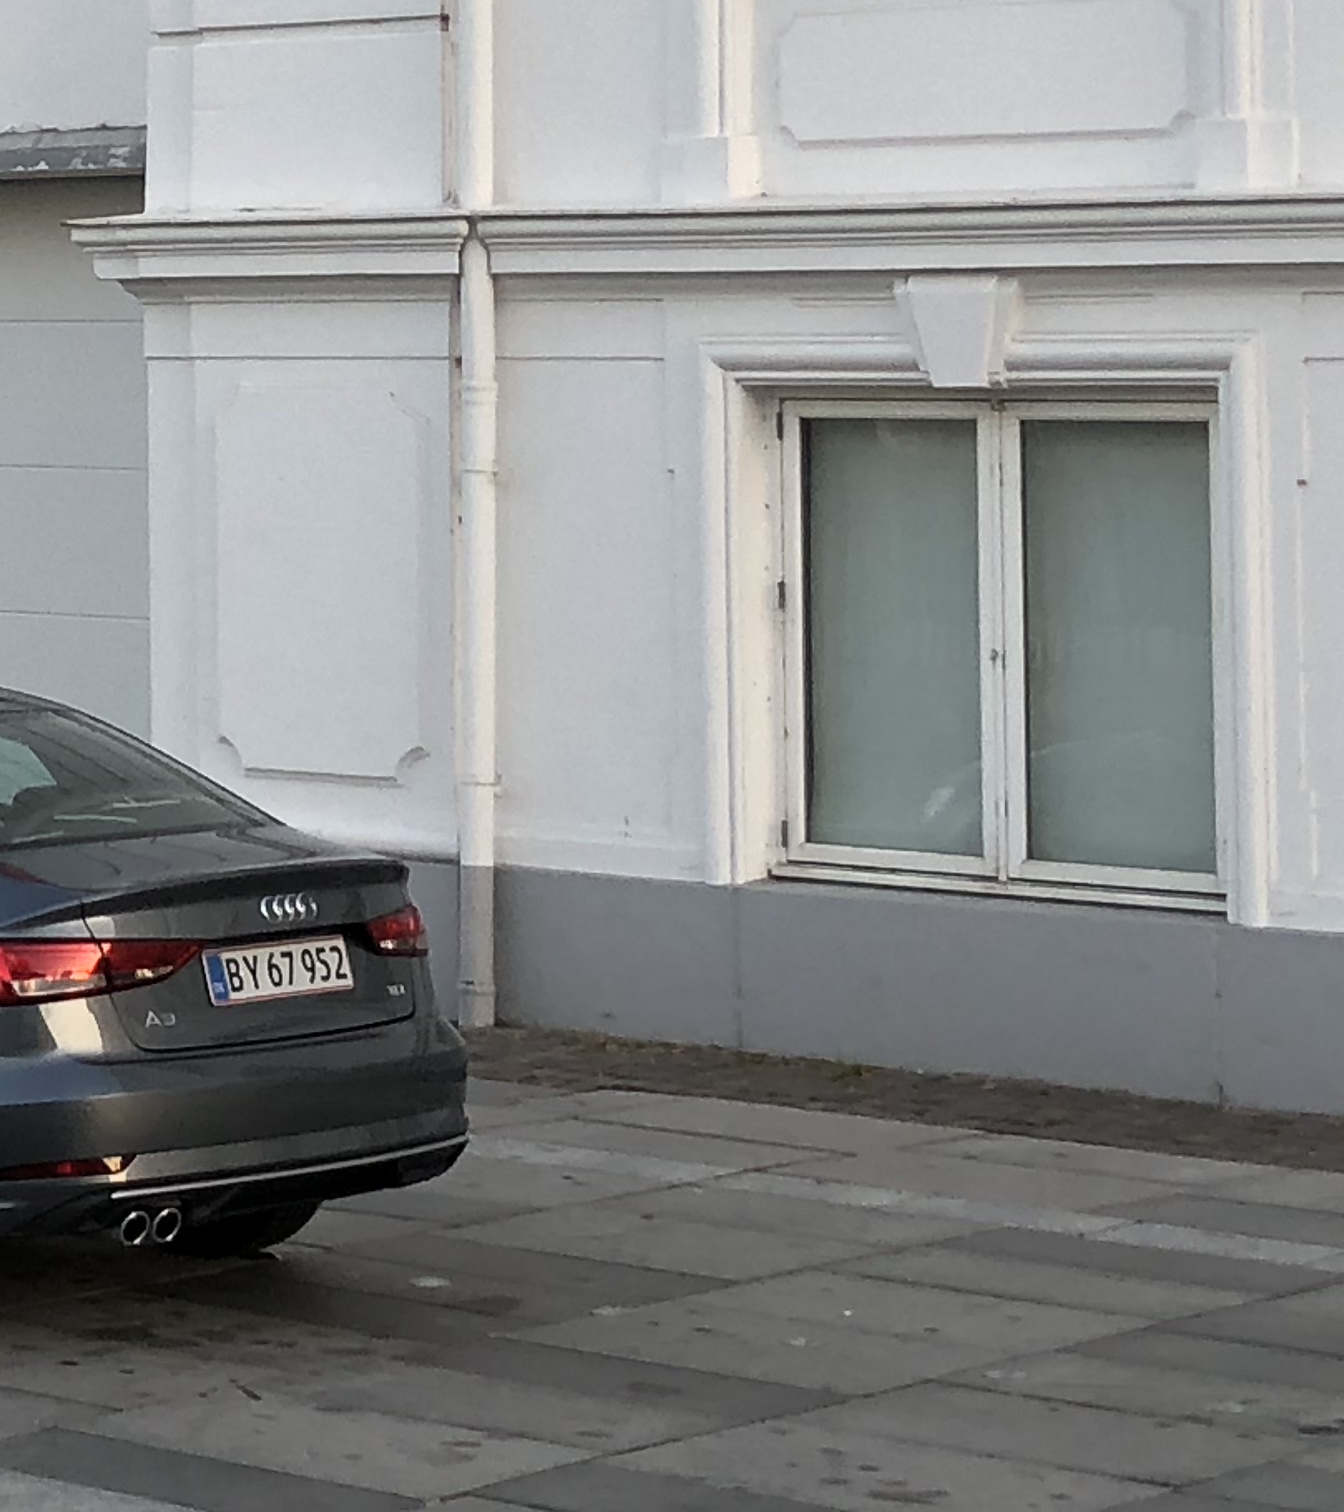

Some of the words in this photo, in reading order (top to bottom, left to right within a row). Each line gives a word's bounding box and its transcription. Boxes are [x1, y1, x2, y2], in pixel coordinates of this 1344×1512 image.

[225, 954, 260, 993] BY
[267, 951, 295, 988] 67
[300, 945, 348, 985] 952
